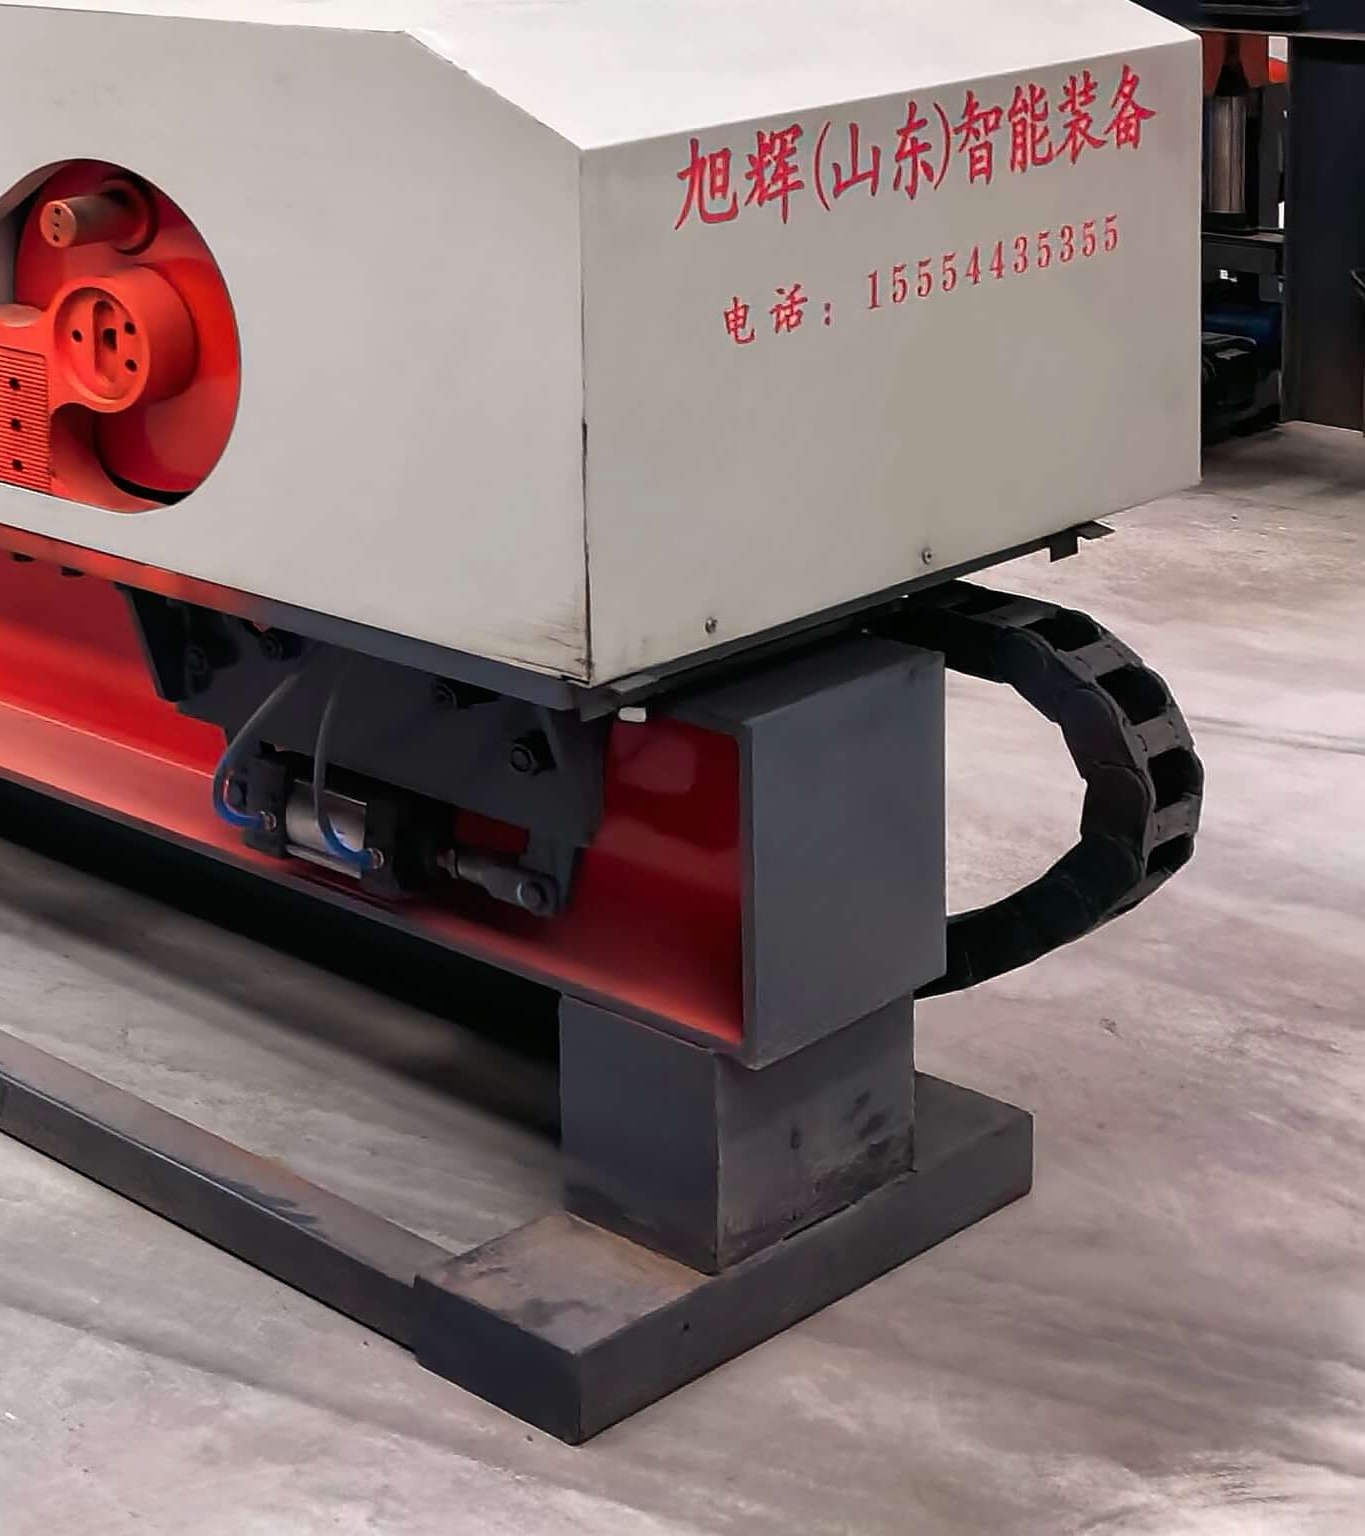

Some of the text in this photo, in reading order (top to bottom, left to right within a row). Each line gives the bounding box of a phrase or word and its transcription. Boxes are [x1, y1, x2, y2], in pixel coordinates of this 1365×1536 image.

[674, 64, 1157, 231] 旭辉(山东)智能装备
